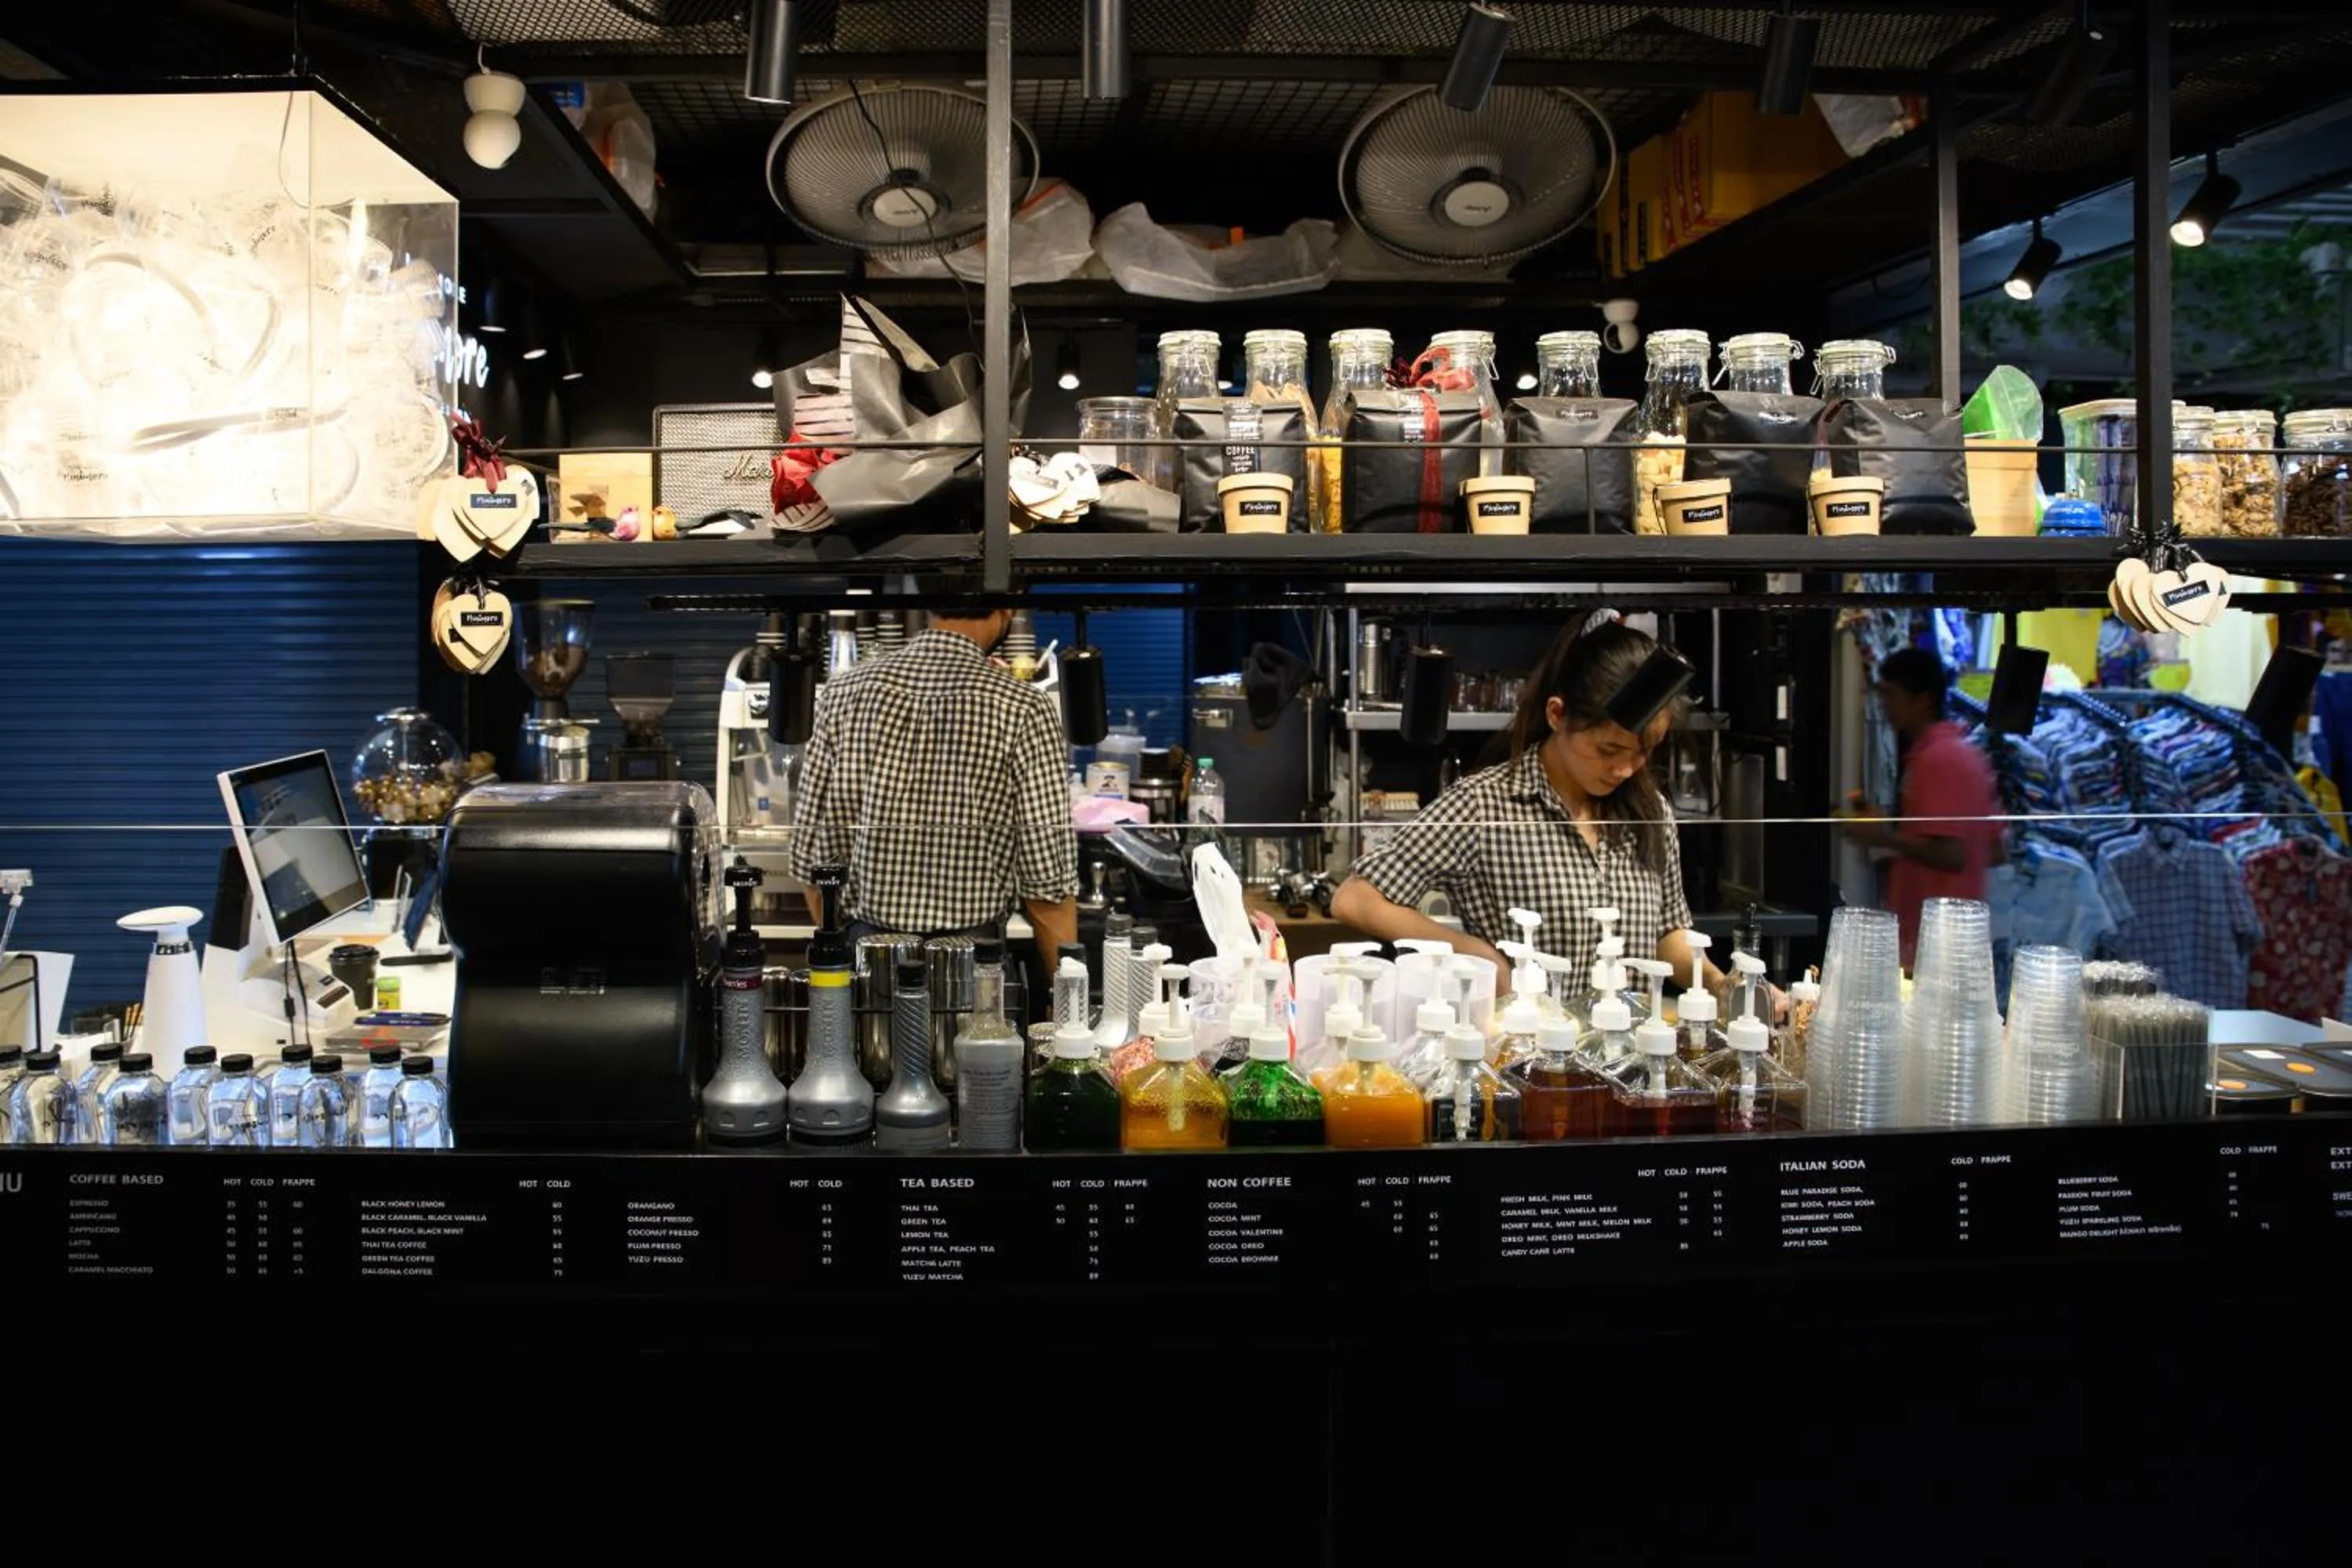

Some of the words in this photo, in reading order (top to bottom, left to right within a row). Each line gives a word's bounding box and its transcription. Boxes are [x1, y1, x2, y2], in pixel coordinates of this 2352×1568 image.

[2248, 1145, 2278, 1153] FRAPPE
[1780, 1160, 1828, 1172] ITALIAN
[1831, 1160, 1866, 1170] SODA
[1950, 1156, 1974, 1166] COLD
[1980, 1155, 2012, 1164] FRAPPE
[1664, 1167, 1688, 1177] COLD
[1695, 1166, 1728, 1175] FRAPPE
[69, 1174, 117, 1184] COFFEE
[122, 1174, 164, 1185] BASED
[789, 1179, 810, 1188] HOT
[818, 1179, 843, 1188] COLD
[899, 1178, 926, 1188] TEA
[931, 1178, 975, 1188] BASED
[1113, 1178, 1149, 1188] FRAPPE
[1207, 1178, 1238, 1188] NON
[1242, 1177, 1291, 1188] COFFEE
[1357, 1177, 1377, 1186] HOT
[1417, 1175, 1451, 1185] FRAPPE
